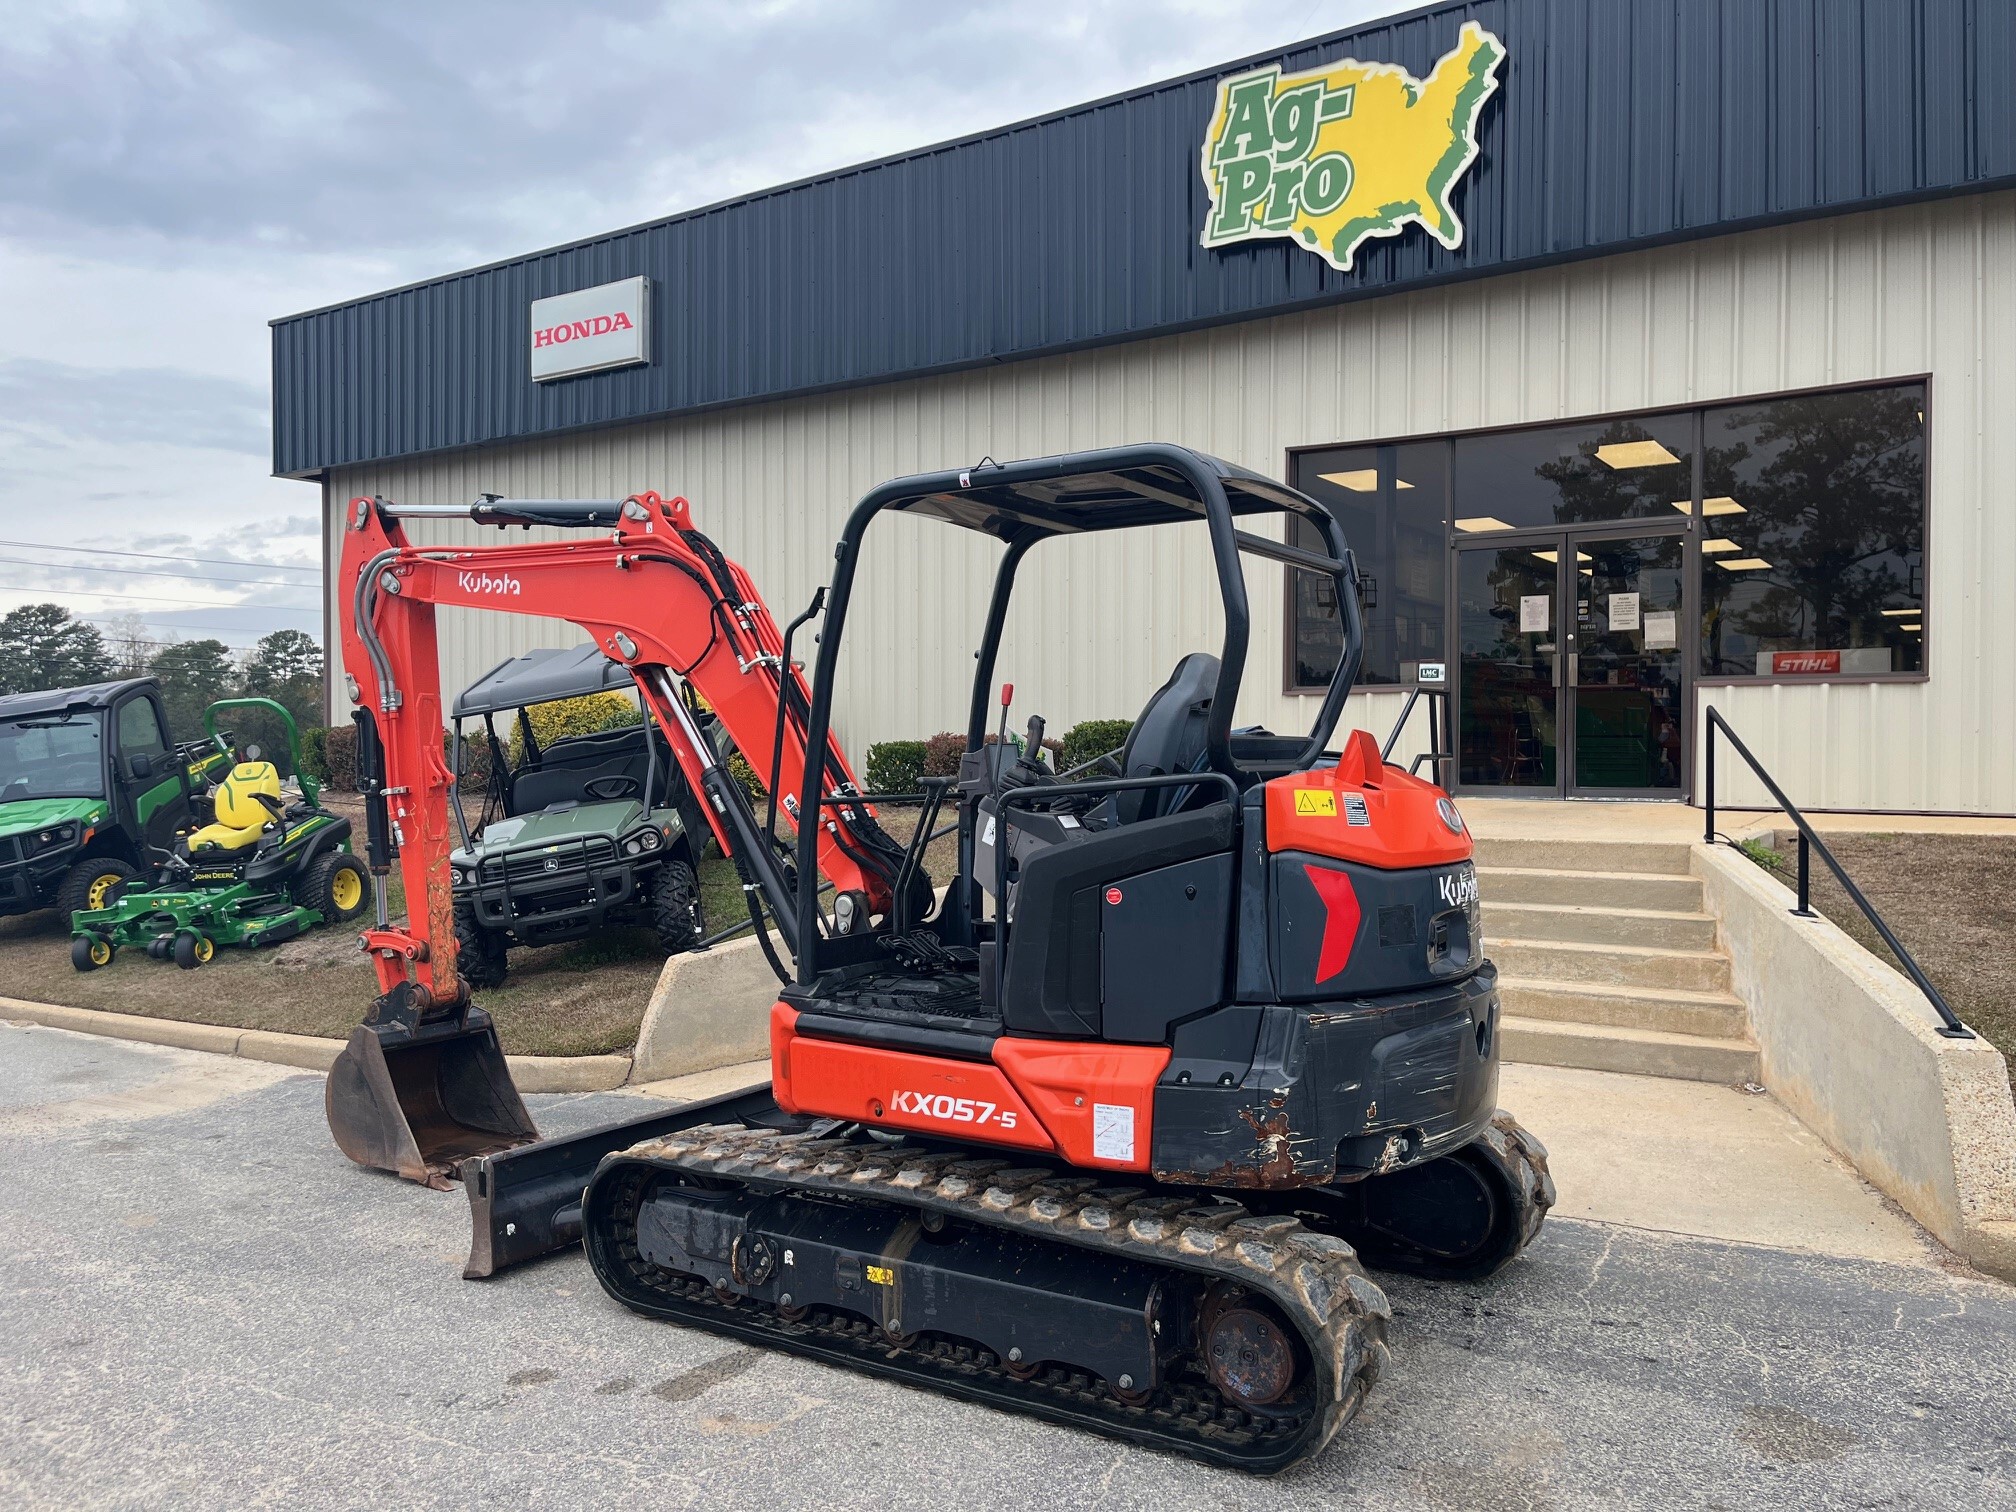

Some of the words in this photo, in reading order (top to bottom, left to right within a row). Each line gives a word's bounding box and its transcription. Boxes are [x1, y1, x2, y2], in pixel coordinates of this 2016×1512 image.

[1210, 71, 1355, 170] Ag-
[1210, 152, 1354, 240] Pro
[534, 312, 634, 349] HONDA
[458, 571, 521, 596] Kubota
[1778, 658, 1832, 672] STIHL
[890, 1089, 1017, 1129] KX057-5
